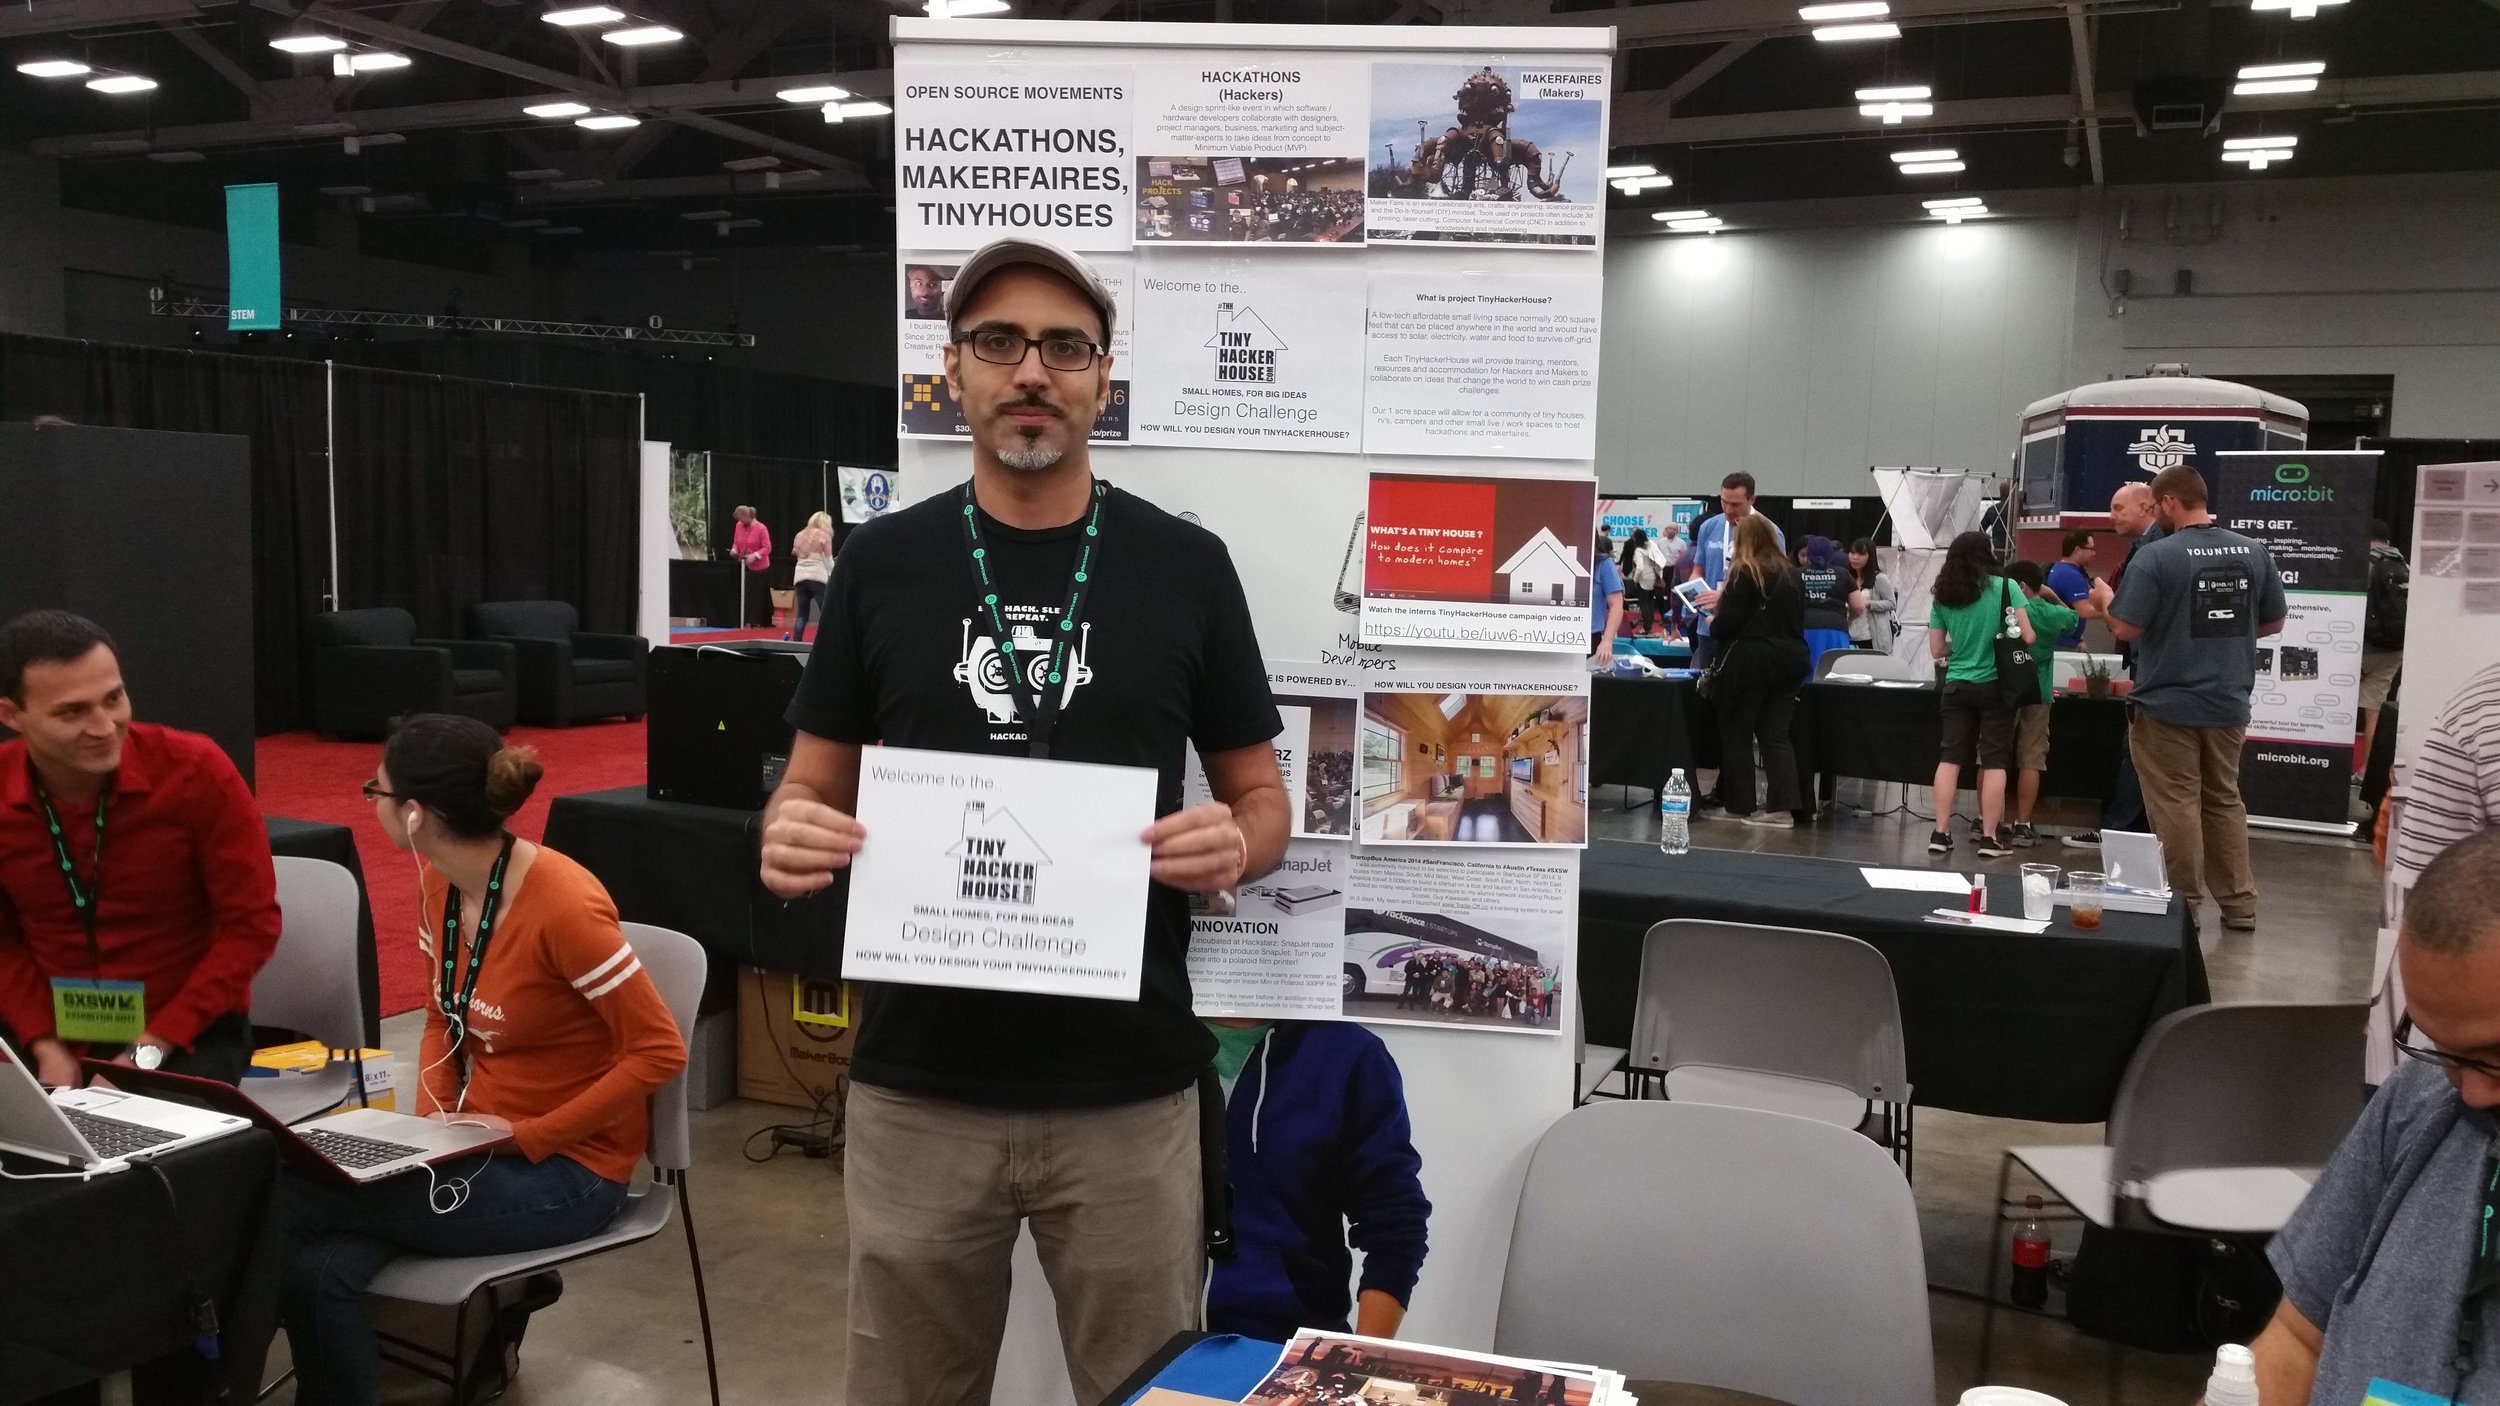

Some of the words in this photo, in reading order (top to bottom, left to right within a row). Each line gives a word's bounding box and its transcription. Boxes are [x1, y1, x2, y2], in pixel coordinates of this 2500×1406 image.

[1202, 71, 1300, 83] HACKATHONS
[1522, 74, 1601, 84] MAKERFAIRES
[906, 86, 948, 99] OPEN
[954, 86, 1018, 99] SOURCE
[1024, 86, 1122, 100] MOVEMENTS
[1219, 89, 1282, 103] (Hackers)
[1539, 88, 1583, 100] (Makers)
[1198, 114, 1239, 123] developers
[1241, 114, 1282, 122] collaborate
[1284, 114, 1298, 122] with
[906, 128, 1123, 160] HACKATHONS,
[1284, 144, 1306, 153] (MVP)
[903, 165, 1127, 197] MAKERFAIRES,
[918, 202, 1112, 227] TINYHOUSES
[1143, 279, 1200, 292] Welcome
[1205, 281, 1216, 293] to
[1416, 294, 1436, 302] What
[1438, 294, 1445, 302] is
[1447, 295, 1475, 304] project
[1477, 295, 1551, 305] TinyHackerHouse?
[232, 310, 254, 319] STEM
[1220, 332, 1251, 347] TINY
[1220, 349, 1274, 364] HACKER
[1383, 354, 1402, 362] Each
[1404, 354, 1469, 366] TinyHackerHouse
[1471, 356, 1483, 364] will
[1485, 356, 1513, 366] provide
[1219, 365, 1264, 380] HOUSE
[1182, 387, 1209, 396] SMALL
[1212, 388, 1243, 398] HOMES,
[1246, 389, 1263, 397] FOR
[1265, 390, 1279, 398] BIG
[1282, 390, 1306, 399] IDEAS
[1174, 401, 1230, 421] Design
[1236, 403, 1317, 424] Challenge
[1140, 424, 1160, 432] HOW
[1162, 424, 1182, 433] WILL
[1184, 425, 1201, 433] YOU
[1204, 426, 1235, 434] DESIGN
[1237, 427, 1260, 435] YOUR
[1263, 428, 1349, 438] TINYHACKERHOUSE?
[2250, 486, 2334, 502] micro:bit
[1603, 516, 1644, 526] CHOOSE
[2231, 520, 2264, 529] LET'S
[1370, 527, 1407, 536] WHAT'S
[1409, 528, 1416, 536] A
[1418, 528, 1440, 537] TINY
[1442, 529, 1475, 538] HOUSE
[1610, 527, 1658, 537] EALTER
[1370, 541, 1390, 551] How
[1394, 542, 1419, 552] does
[1424, 543, 1434, 553] it
[1439, 546, 1483, 557] compare
[2187, 546, 2250, 556] VOLUNTEER
[1378, 553, 1390, 563] to
[1395, 554, 1433, 565] modern
[1438, 556, 1476, 566] homes?
[1368, 607, 1392, 615] Watch
[1394, 608, 1406, 616] the
[1409, 608, 1435, 617] interns
[1439, 609, 1506, 621] TinyHackerHouse
[1509, 612, 1547, 622] campaign
[1549, 613, 1571, 622] video
[1573, 614, 1583, 622] at:
[1287, 676, 1332, 685] POWERED
[1374, 681, 1393, 689] HOW
[1395, 681, 1414, 689] WILL
[1417, 681, 1433, 689] YOU
[1436, 682, 1466, 690] DESIGN
[1468, 682, 1490, 690] YOUR
[1493, 682, 1577, 691] TINYHACKERHOUSE?
[2257, 752, 2329, 768] microbit.org
[872, 766, 944, 787] Welcome
[951, 773, 964, 788] to
[966, 838, 1006, 856] TINY
[1350, 854, 1381, 864] StartupBus
[1383, 856, 1406, 864] America
[963, 859, 1034, 881] HACKER
[962, 881, 1021, 900] HOUSE
[913, 905, 947, 918] SMALL
[952, 908, 992, 924] HOMES,
[996, 912, 1017, 923] FOR
[1021, 913, 1038, 925] BIG
[1042, 915, 1073, 927] IDEAS
[1191, 920, 1278, 934] NNOVATION
[902, 923, 973, 952] Design
[982, 929, 1086, 960] Challenge
[856, 950, 881, 962] HOW
[885, 952, 908, 964] WILL
[914, 954, 935, 966] YOU
[939, 956, 978, 969] DESIGN
[983, 959, 1011, 971] YOUR
[1017, 962, 1125, 979] TINYHACKERHOUSE?
